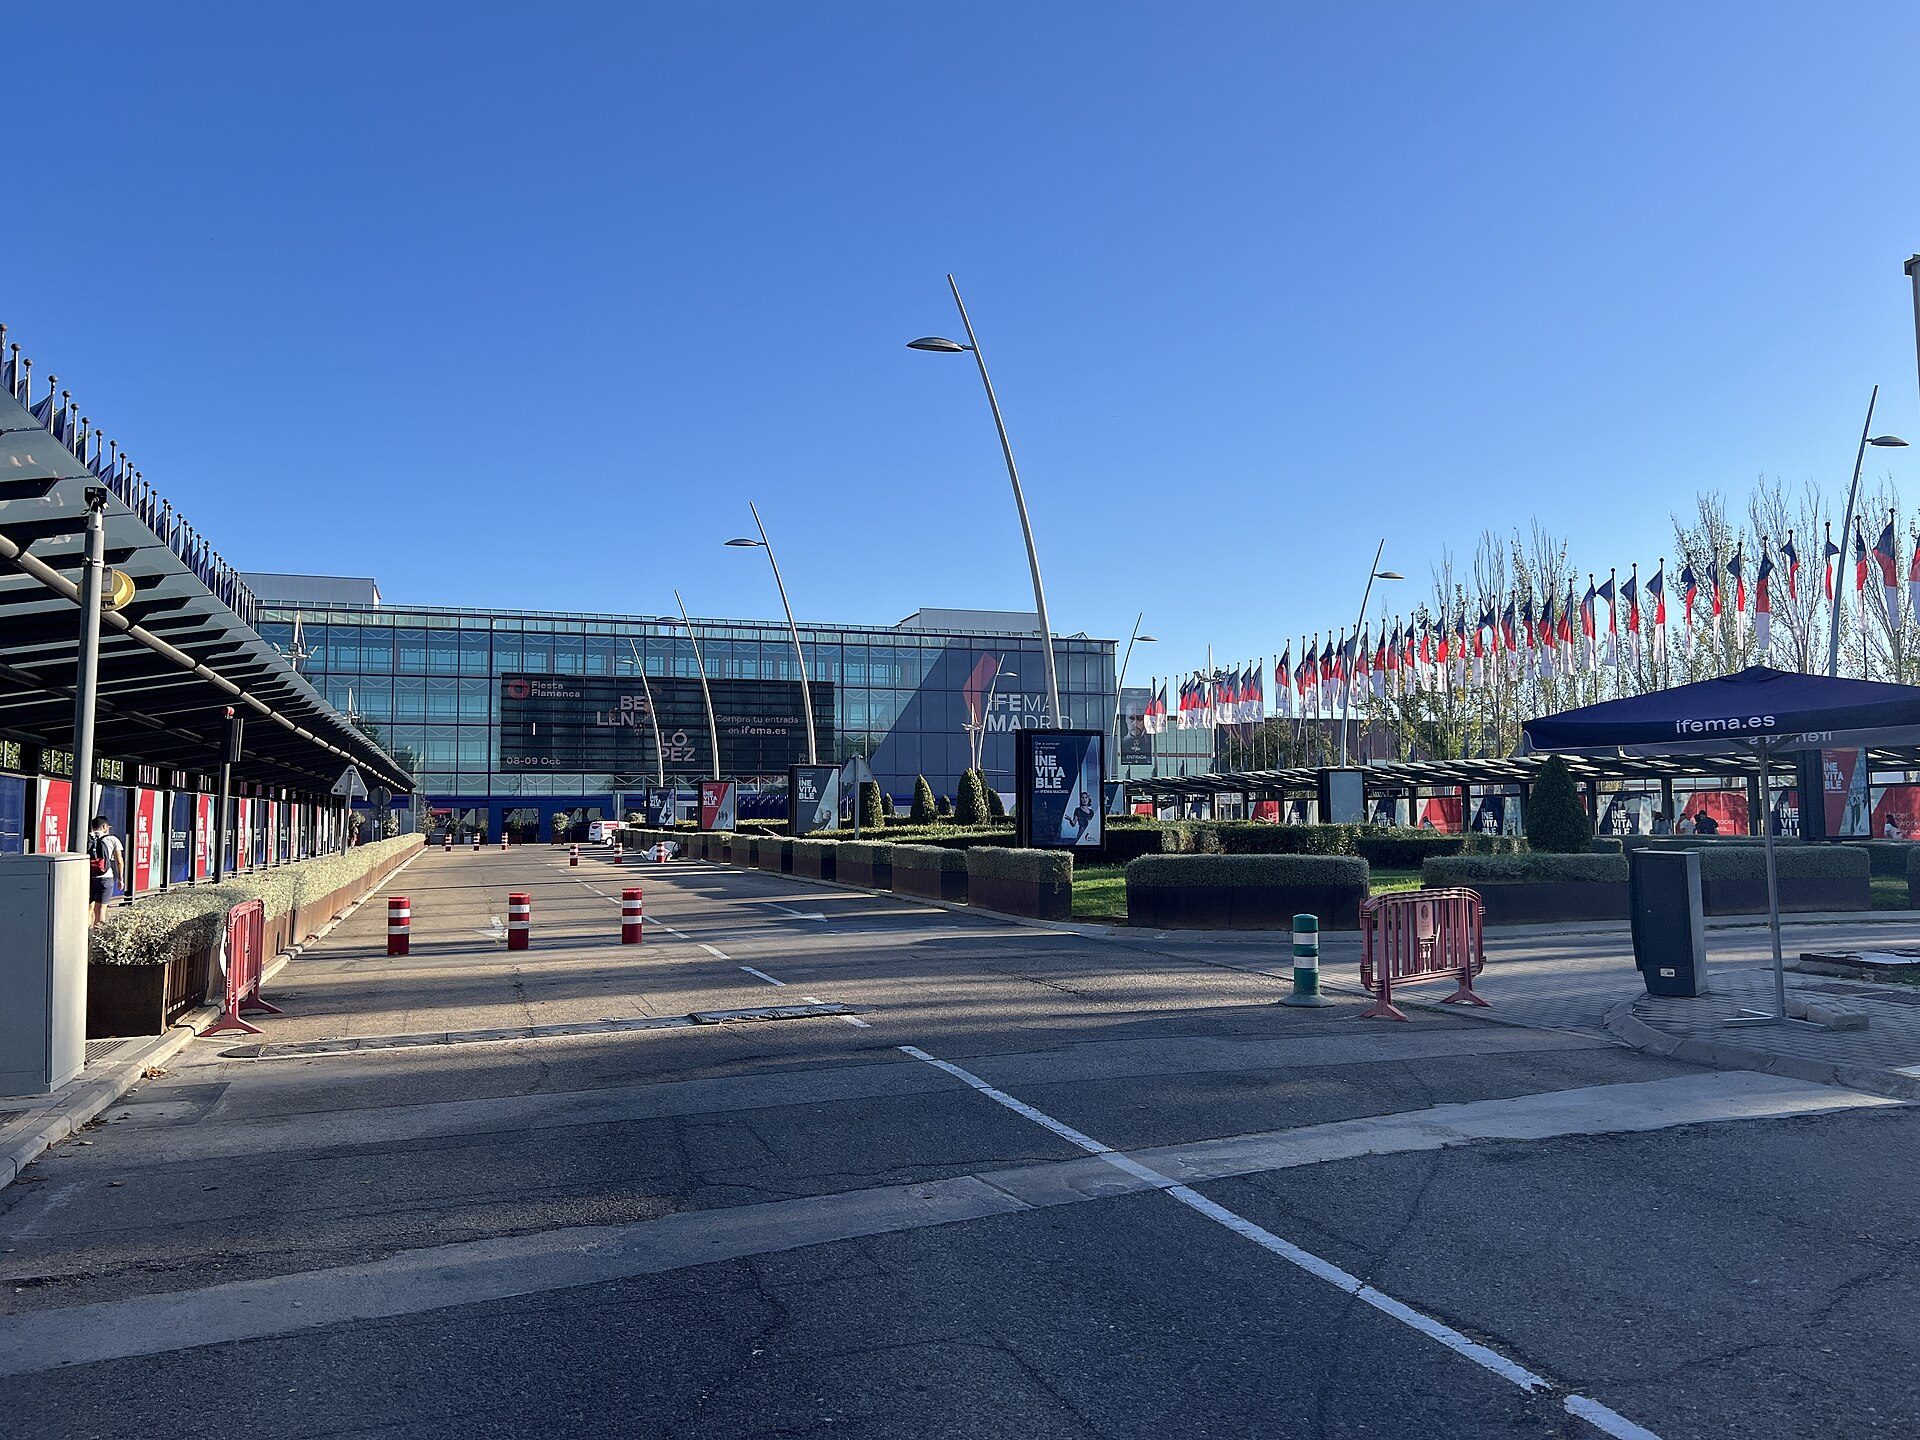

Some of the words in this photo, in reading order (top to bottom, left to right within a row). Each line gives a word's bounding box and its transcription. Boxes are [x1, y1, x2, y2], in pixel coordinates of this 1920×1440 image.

[531, 681, 563, 689] Fiesta
[531, 689, 581, 697] Flamenca
[621, 696, 645, 710] BE
[716, 715, 750, 723] Compra
[765, 716, 799, 724] entrada
[988, 715, 1073, 731] MADRD
[1676, 715, 1776, 734] ifema.es
[741, 726, 787, 735] ifema.es
[661, 729, 687, 746] LÓ
[1035, 755, 1056, 766] INE
[1824, 762, 1837, 771] INE
[1035, 767, 1065, 777] VITA
[1824, 772, 1844, 780] VITA
[1036, 778, 1061, 788] BLE
[1825, 781, 1841, 789] BLE
[1611, 810, 1626, 818] INE
[1780, 808, 1799, 818] INE
[45, 816, 58, 834] INE
[1612, 819, 1632, 828] VITA
[1780, 819, 1799, 828] VIT
